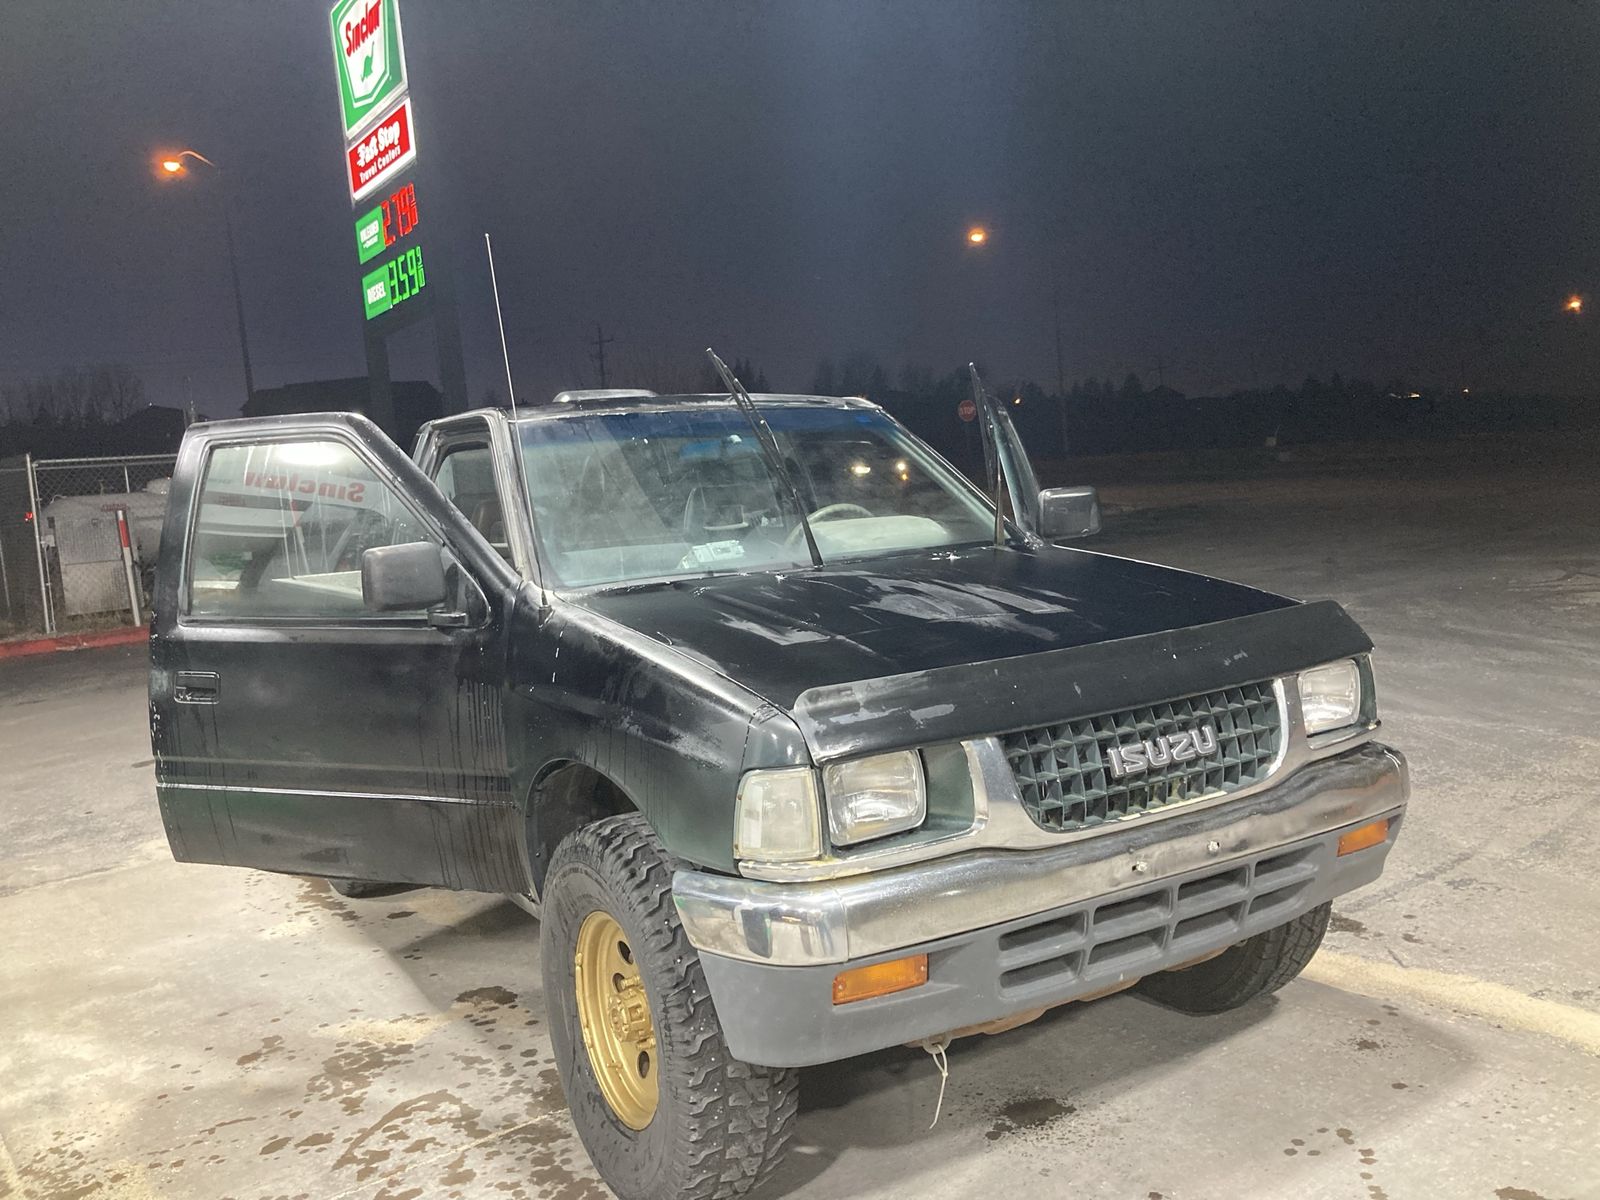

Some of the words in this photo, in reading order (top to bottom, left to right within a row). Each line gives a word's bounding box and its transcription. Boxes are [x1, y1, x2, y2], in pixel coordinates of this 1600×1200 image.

[345, 0, 381, 57] Sinclair
[357, 135, 378, 167] Fast
[378, 121, 400, 152] Stop
[360, 161, 377, 184] Travel
[959, 406, 976, 415] STOP
[1107, 725, 1217, 779] ISUZU
